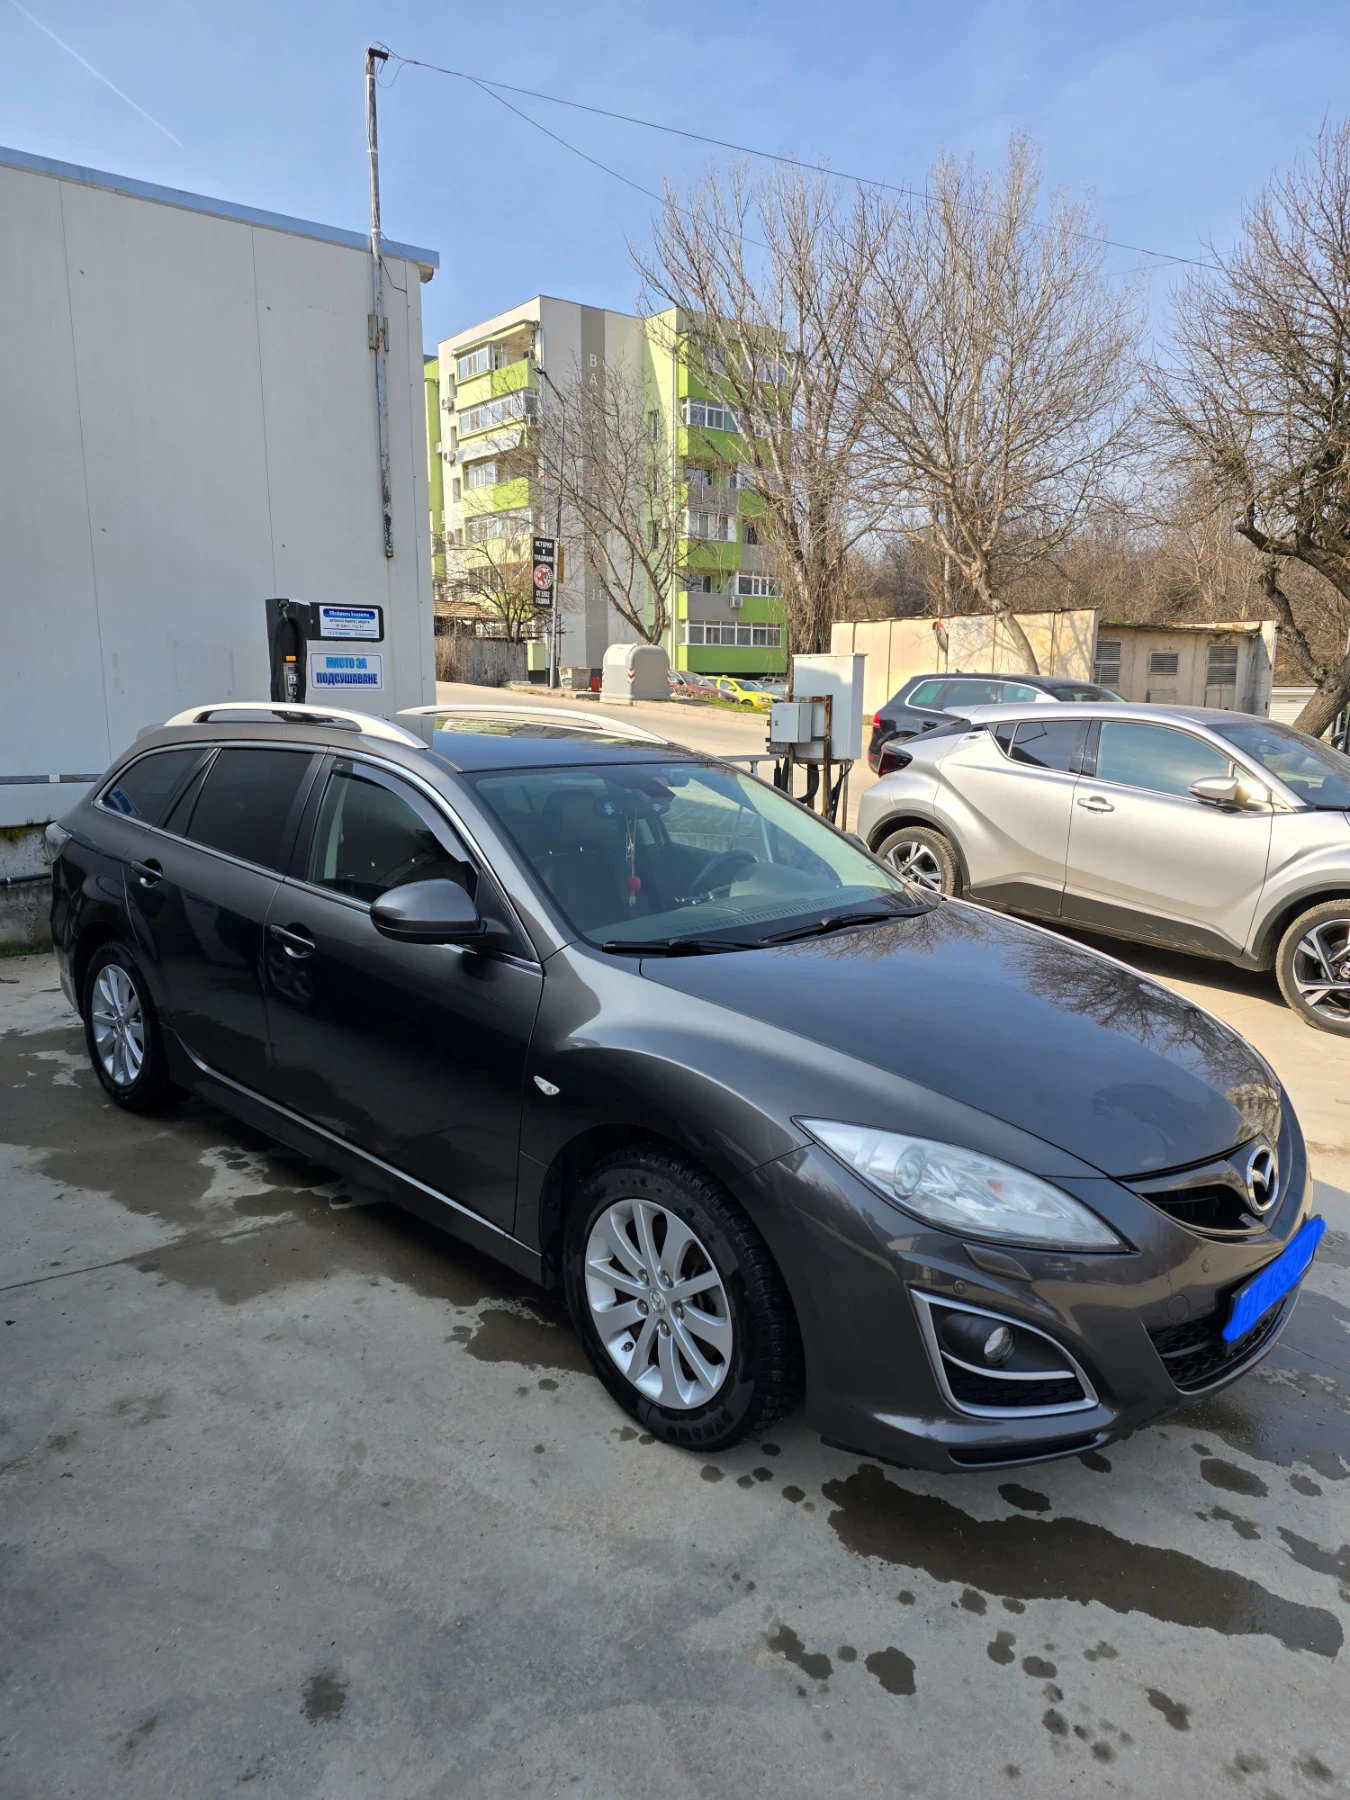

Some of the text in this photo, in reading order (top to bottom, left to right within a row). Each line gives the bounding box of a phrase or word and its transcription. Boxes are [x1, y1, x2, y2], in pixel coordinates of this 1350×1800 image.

[326, 657, 367, 669] МЯСТО ЗА
[316, 672, 378, 685] ПОДСУШАВАНЕ
